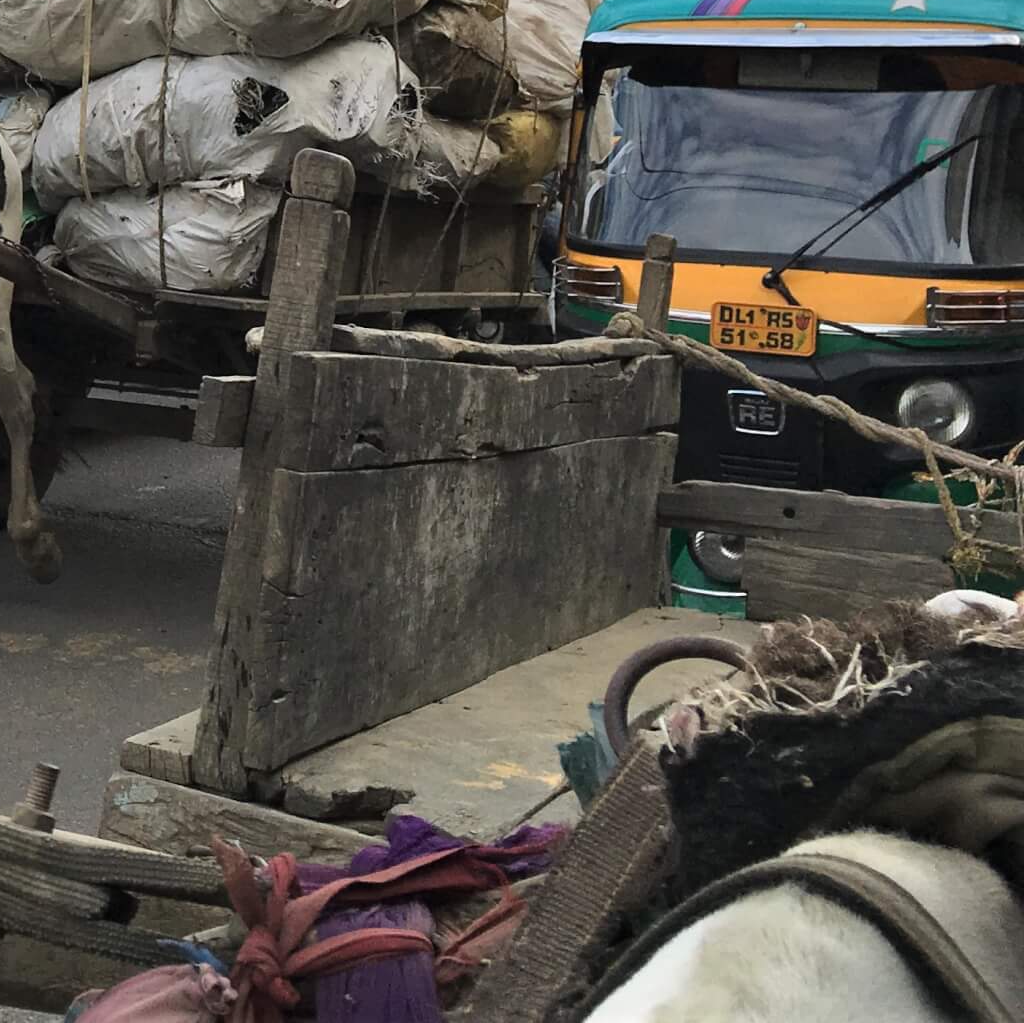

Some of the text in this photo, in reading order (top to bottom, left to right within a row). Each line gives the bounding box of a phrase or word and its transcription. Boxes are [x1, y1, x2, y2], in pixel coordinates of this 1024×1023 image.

[719, 305, 755, 324] DL1
[720, 327, 794, 349] 51 58
[739, 403, 776, 426] RE
